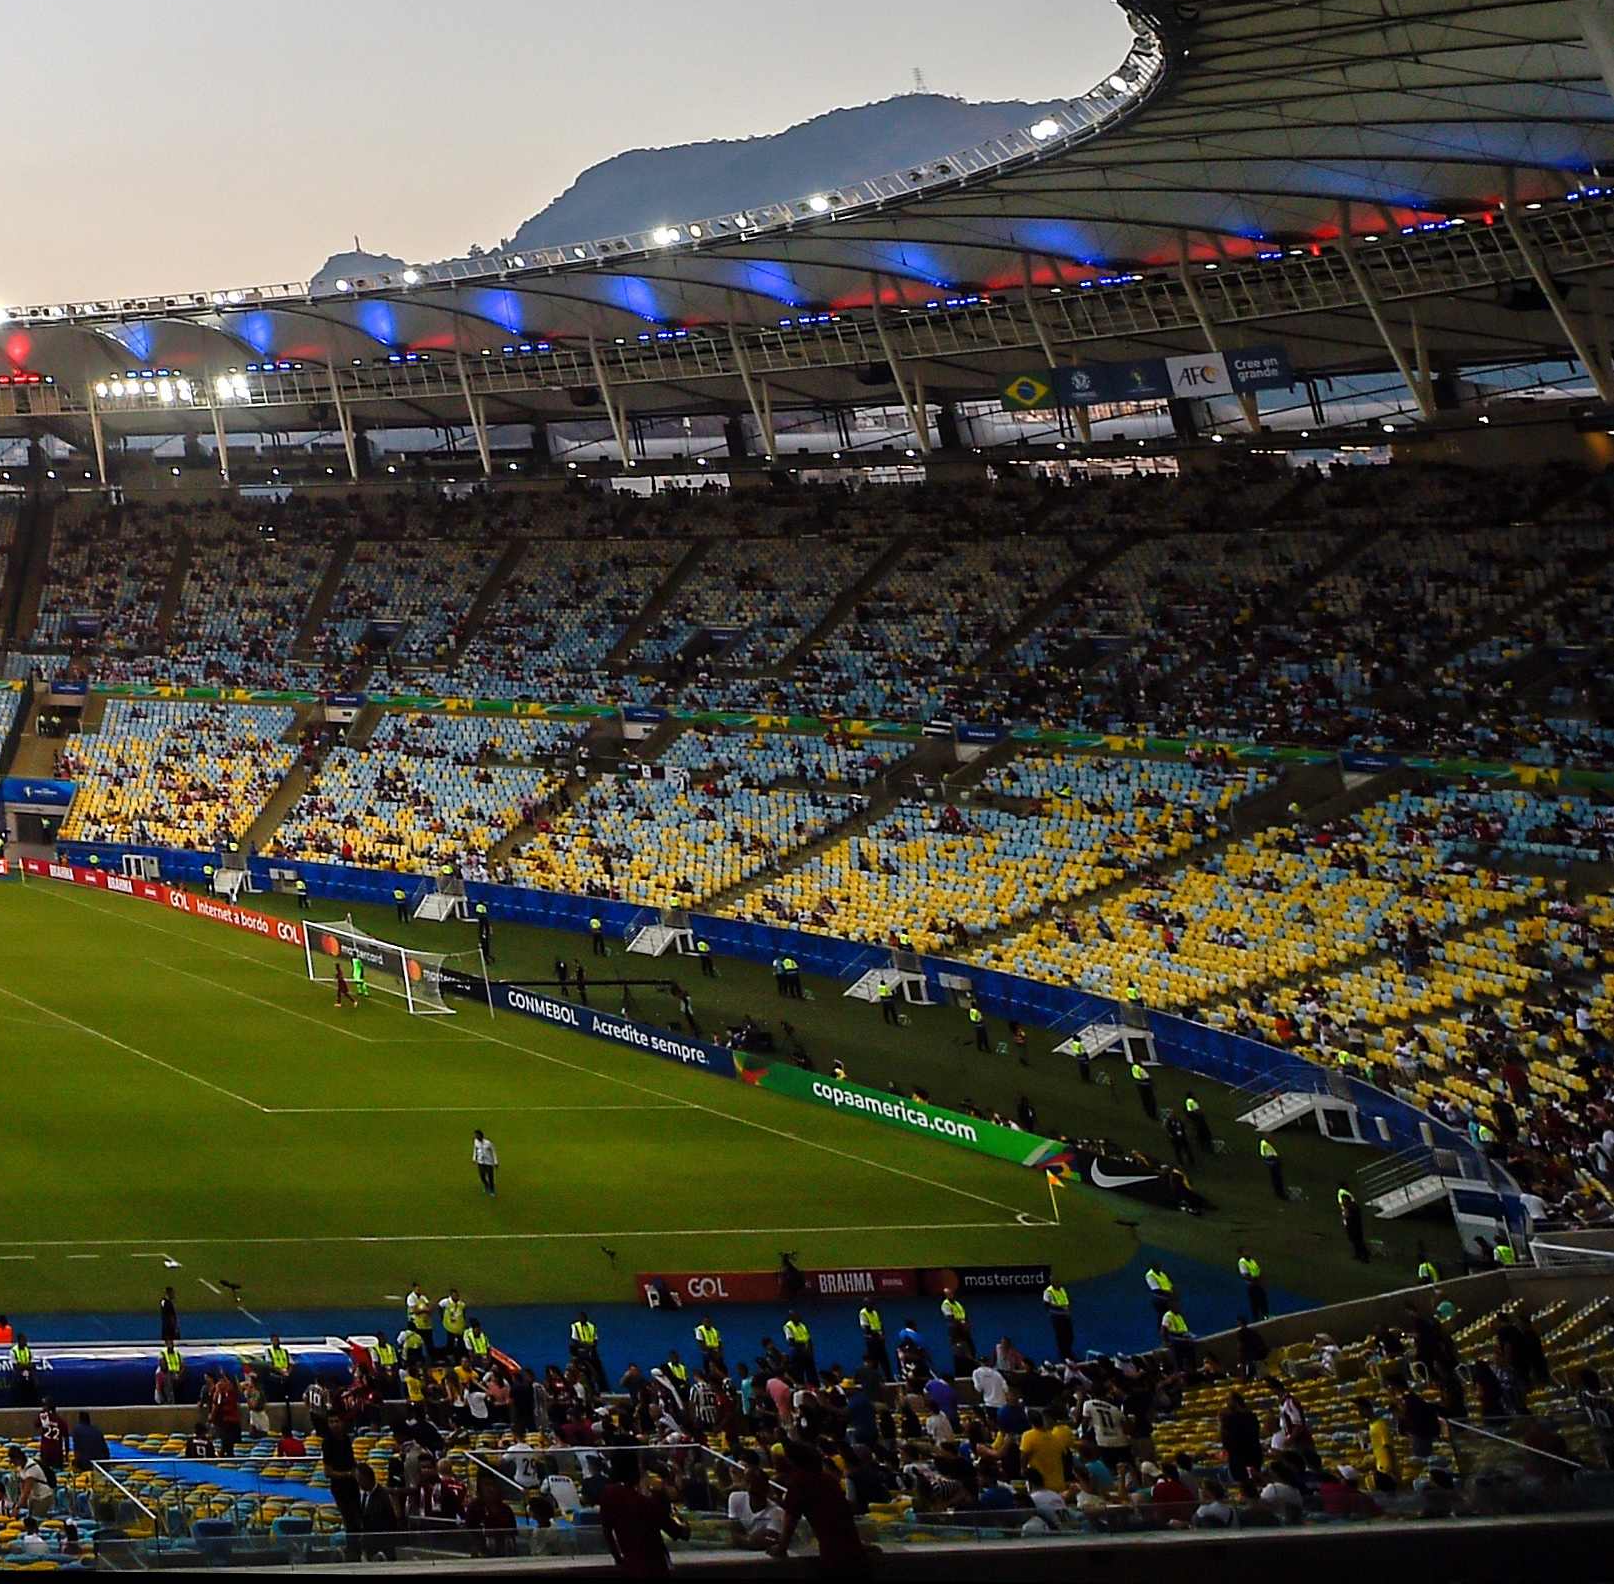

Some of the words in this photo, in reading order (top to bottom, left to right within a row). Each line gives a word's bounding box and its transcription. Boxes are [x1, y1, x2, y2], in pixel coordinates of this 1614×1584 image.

[1234, 359, 1260, 371] Cree
[1264, 357, 1278, 368] en
[1237, 367, 1279, 383] grande
[169, 890, 190, 913] GOL
[197, 898, 232, 923] Internet
[241, 912, 269, 934] bordo
[277, 920, 301, 945] GOL
[507, 990, 579, 1026] CONMEBOL
[592, 1015, 649, 1048] Acredite
[812, 1079, 977, 1143] copaamerica.com
[687, 1277, 729, 1298] GOL
[818, 1273, 875, 1294] BRAHMA
[965, 1271, 1044, 1287] mastercard
[43, 1426, 60, 1440] 22
